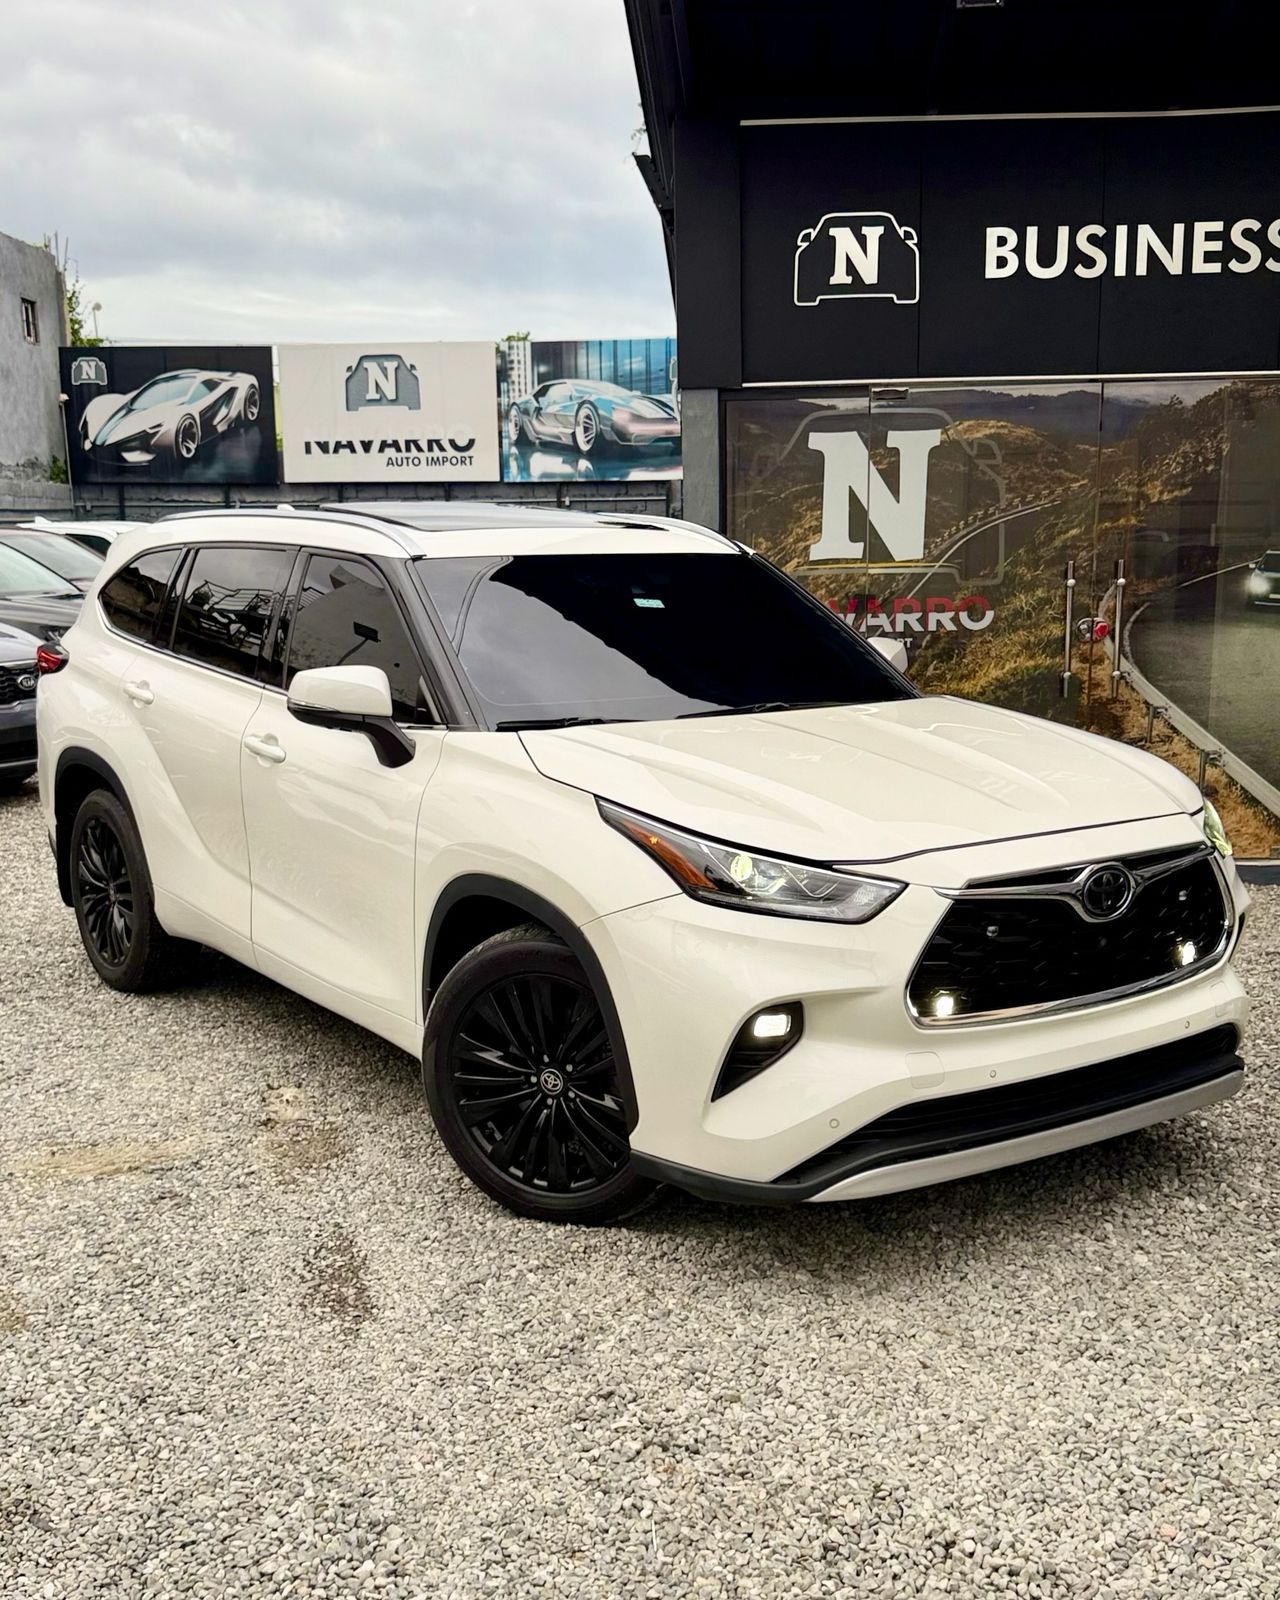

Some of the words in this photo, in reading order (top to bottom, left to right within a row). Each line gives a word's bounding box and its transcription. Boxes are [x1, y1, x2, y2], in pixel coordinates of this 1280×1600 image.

[828, 226, 885, 285] N
[80, 361, 97, 380] N
[363, 361, 399, 401] N
[386, 456, 422, 468] AUTO
[426, 455, 475, 467] IMPORT
[807, 429, 942, 562] N
